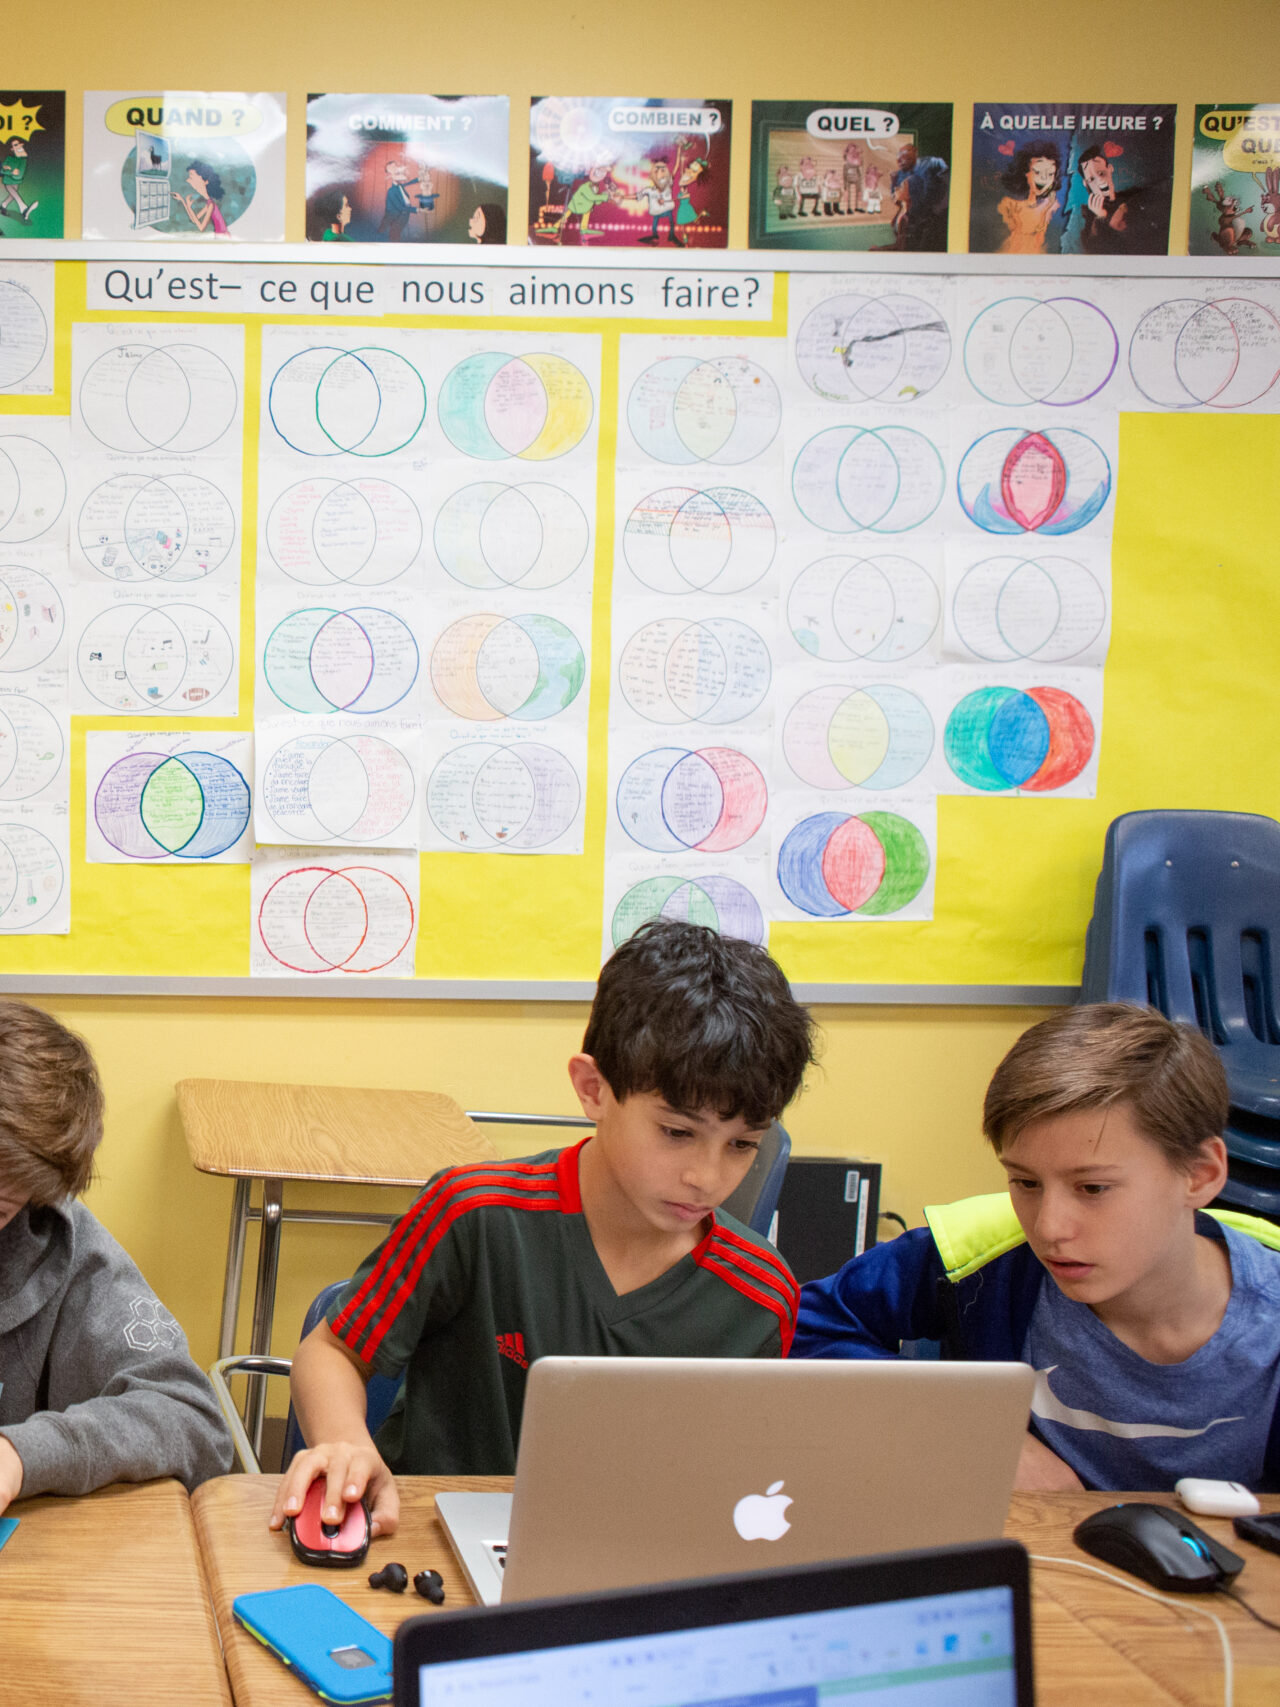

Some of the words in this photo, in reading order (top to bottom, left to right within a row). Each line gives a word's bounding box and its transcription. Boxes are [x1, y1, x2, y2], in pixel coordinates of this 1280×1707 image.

[21, 112, 34, 129] ?
[126, 107, 223, 127] QUAND
[231, 107, 245, 126] ?
[348, 113, 456, 131] COMMENT
[461, 113, 473, 130] ?
[612, 110, 702, 126] COMBIEN
[708, 111, 719, 127] ?
[816, 115, 875, 133] QUEL
[882, 115, 894, 132] ?
[980, 110, 993, 129] À
[999, 114, 1077, 132] QUELLE
[1081, 114, 1148, 131] HEURE
[1153, 115, 1163, 130] ?
[260, 280, 297, 302] ce
[310, 280, 375, 310] que
[402, 279, 485, 304] nous
[509, 276, 635, 305] aimons
[661, 276, 760, 308] faire?
